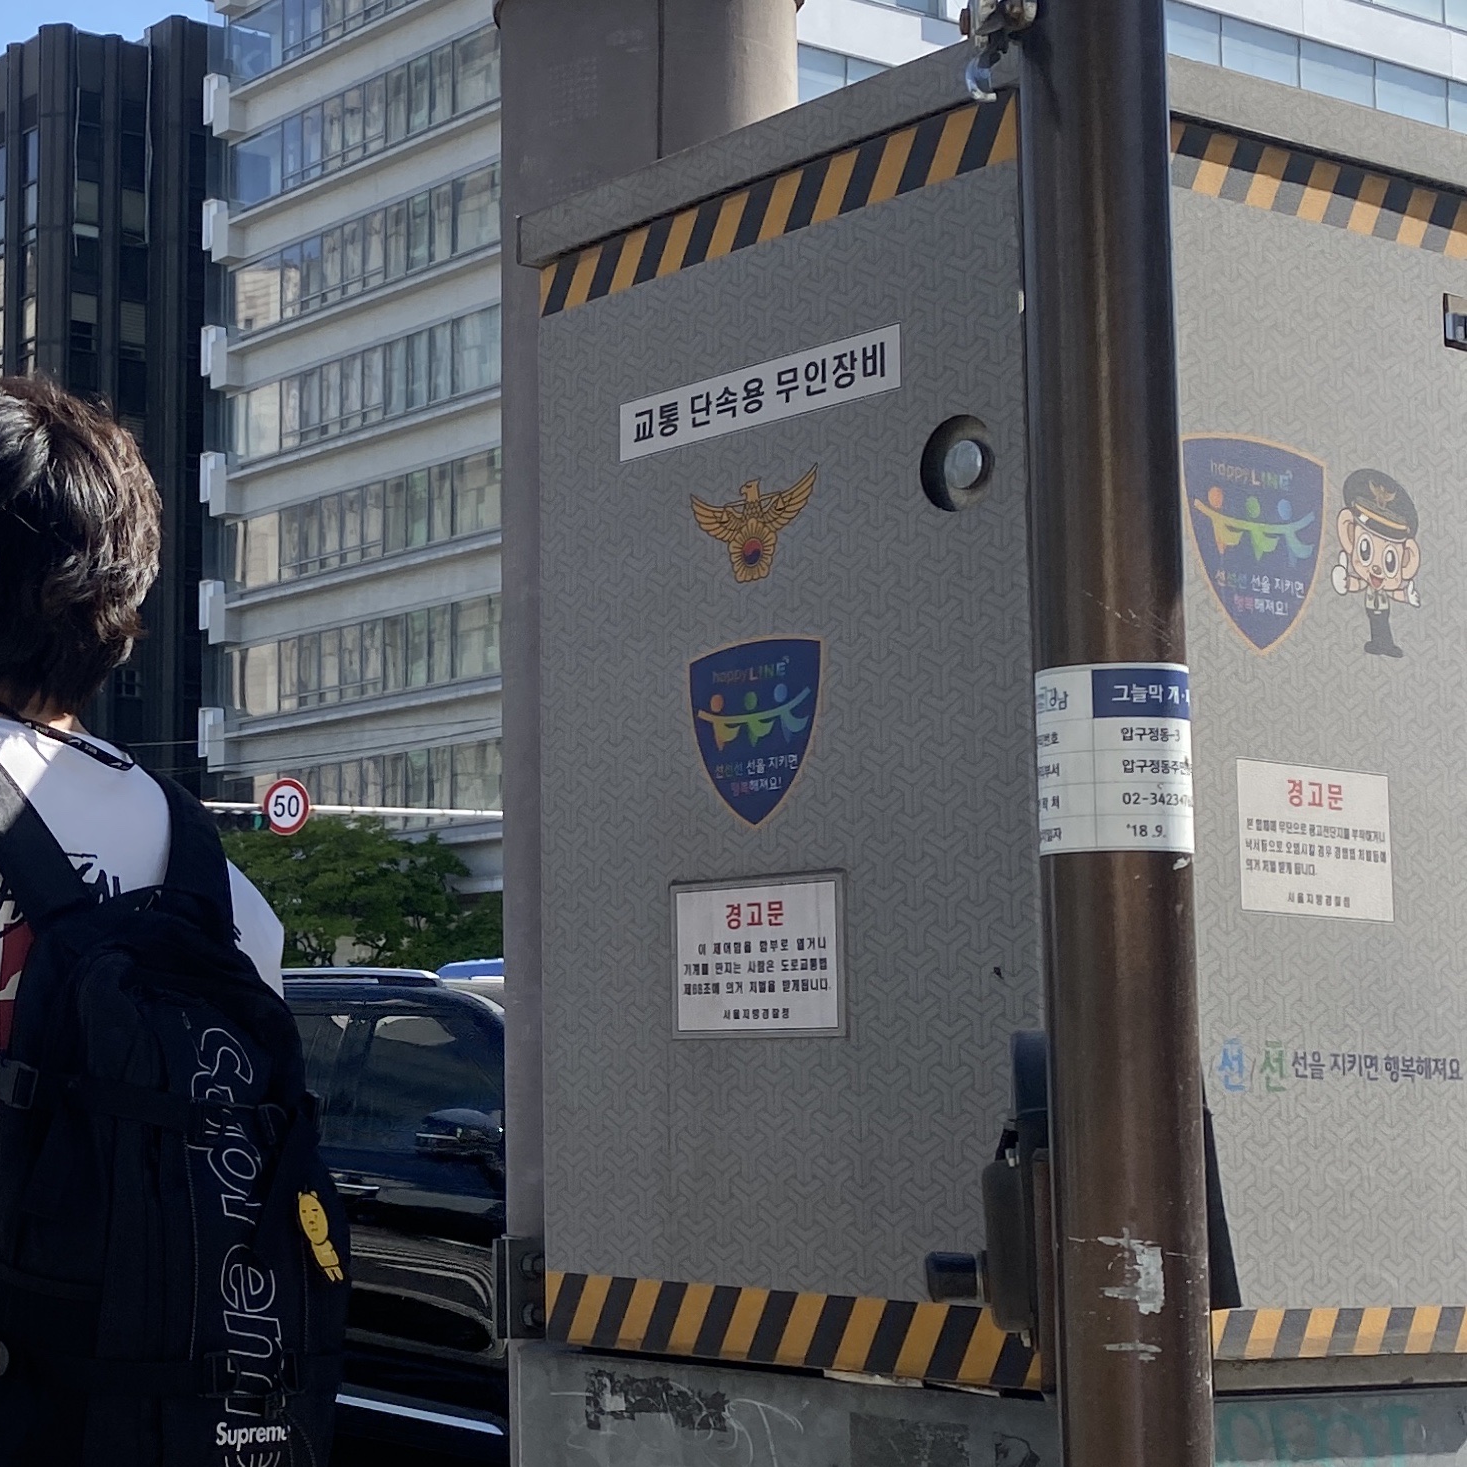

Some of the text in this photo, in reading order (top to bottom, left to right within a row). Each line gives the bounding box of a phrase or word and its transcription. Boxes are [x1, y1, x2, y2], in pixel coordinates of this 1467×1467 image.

[634, 342, 886, 443] 교통 단속용 무인장비
[1250, 574, 1271, 594] 선을
[1274, 577, 1305, 599] 지키면
[1112, 683, 1163, 704] 그늘막
[1121, 727, 1181, 742] 압구정동-3
[746, 758, 766, 775] 선을
[768, 754, 798, 770] 지키면
[1287, 779, 1343, 811] 경고문
[273, 795, 300, 818] 50
[725, 900, 784, 930] 경고문
[759, 938, 789, 953] 함부로
[796, 936, 827, 951] 열거나
[715, 961, 741, 975] 만지는
[747, 959, 774, 974] 사람은
[781, 957, 827, 972] 도로교통법
[726, 981, 744, 994] 의거
[1217, 1047, 1464, 1092] 선 선 선을 지키면 행복해져요
